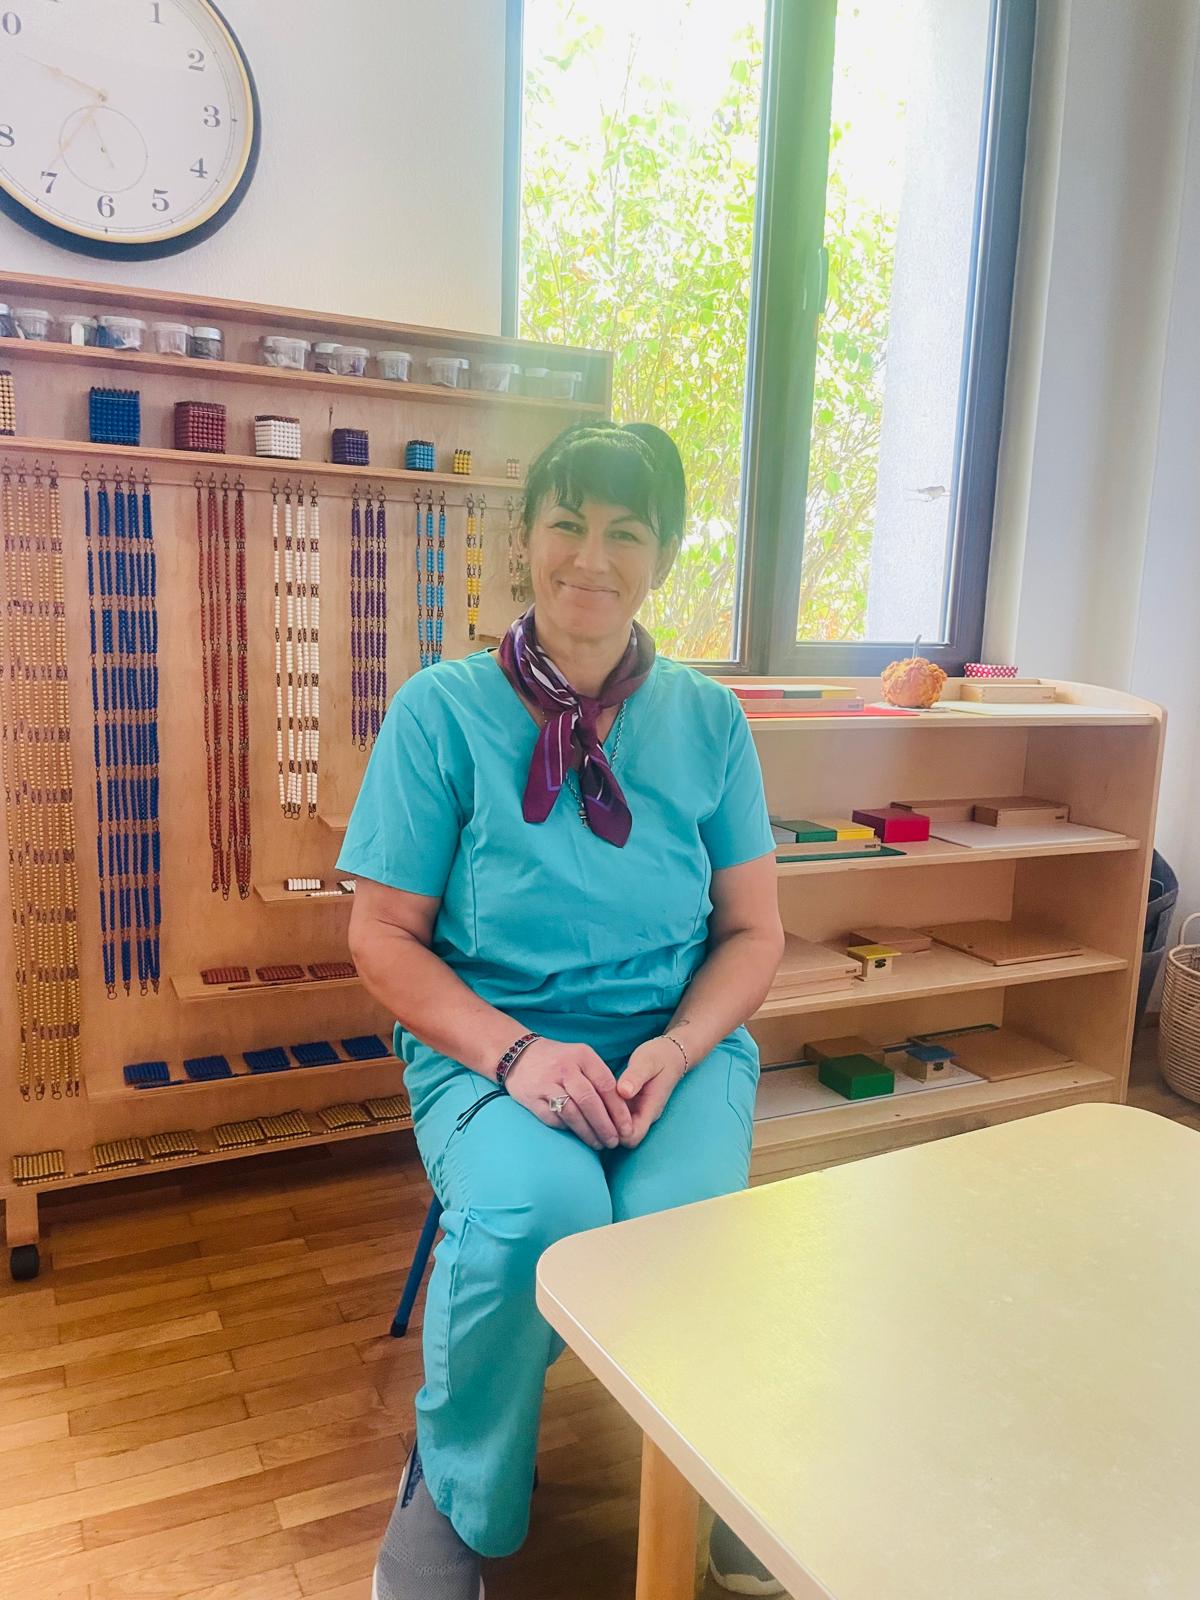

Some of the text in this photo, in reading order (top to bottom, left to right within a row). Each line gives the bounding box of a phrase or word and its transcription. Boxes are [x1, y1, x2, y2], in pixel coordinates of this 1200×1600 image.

[1, 12, 22, 36] 0
[151, 2, 164, 25] 1
[187, 49, 206, 72] 2
[203, 105, 221, 128] 3
[190, 157, 208, 179] 4
[41, 171, 58, 194] 7
[97, 194, 115, 218] 6
[152, 189, 170, 212] 5
